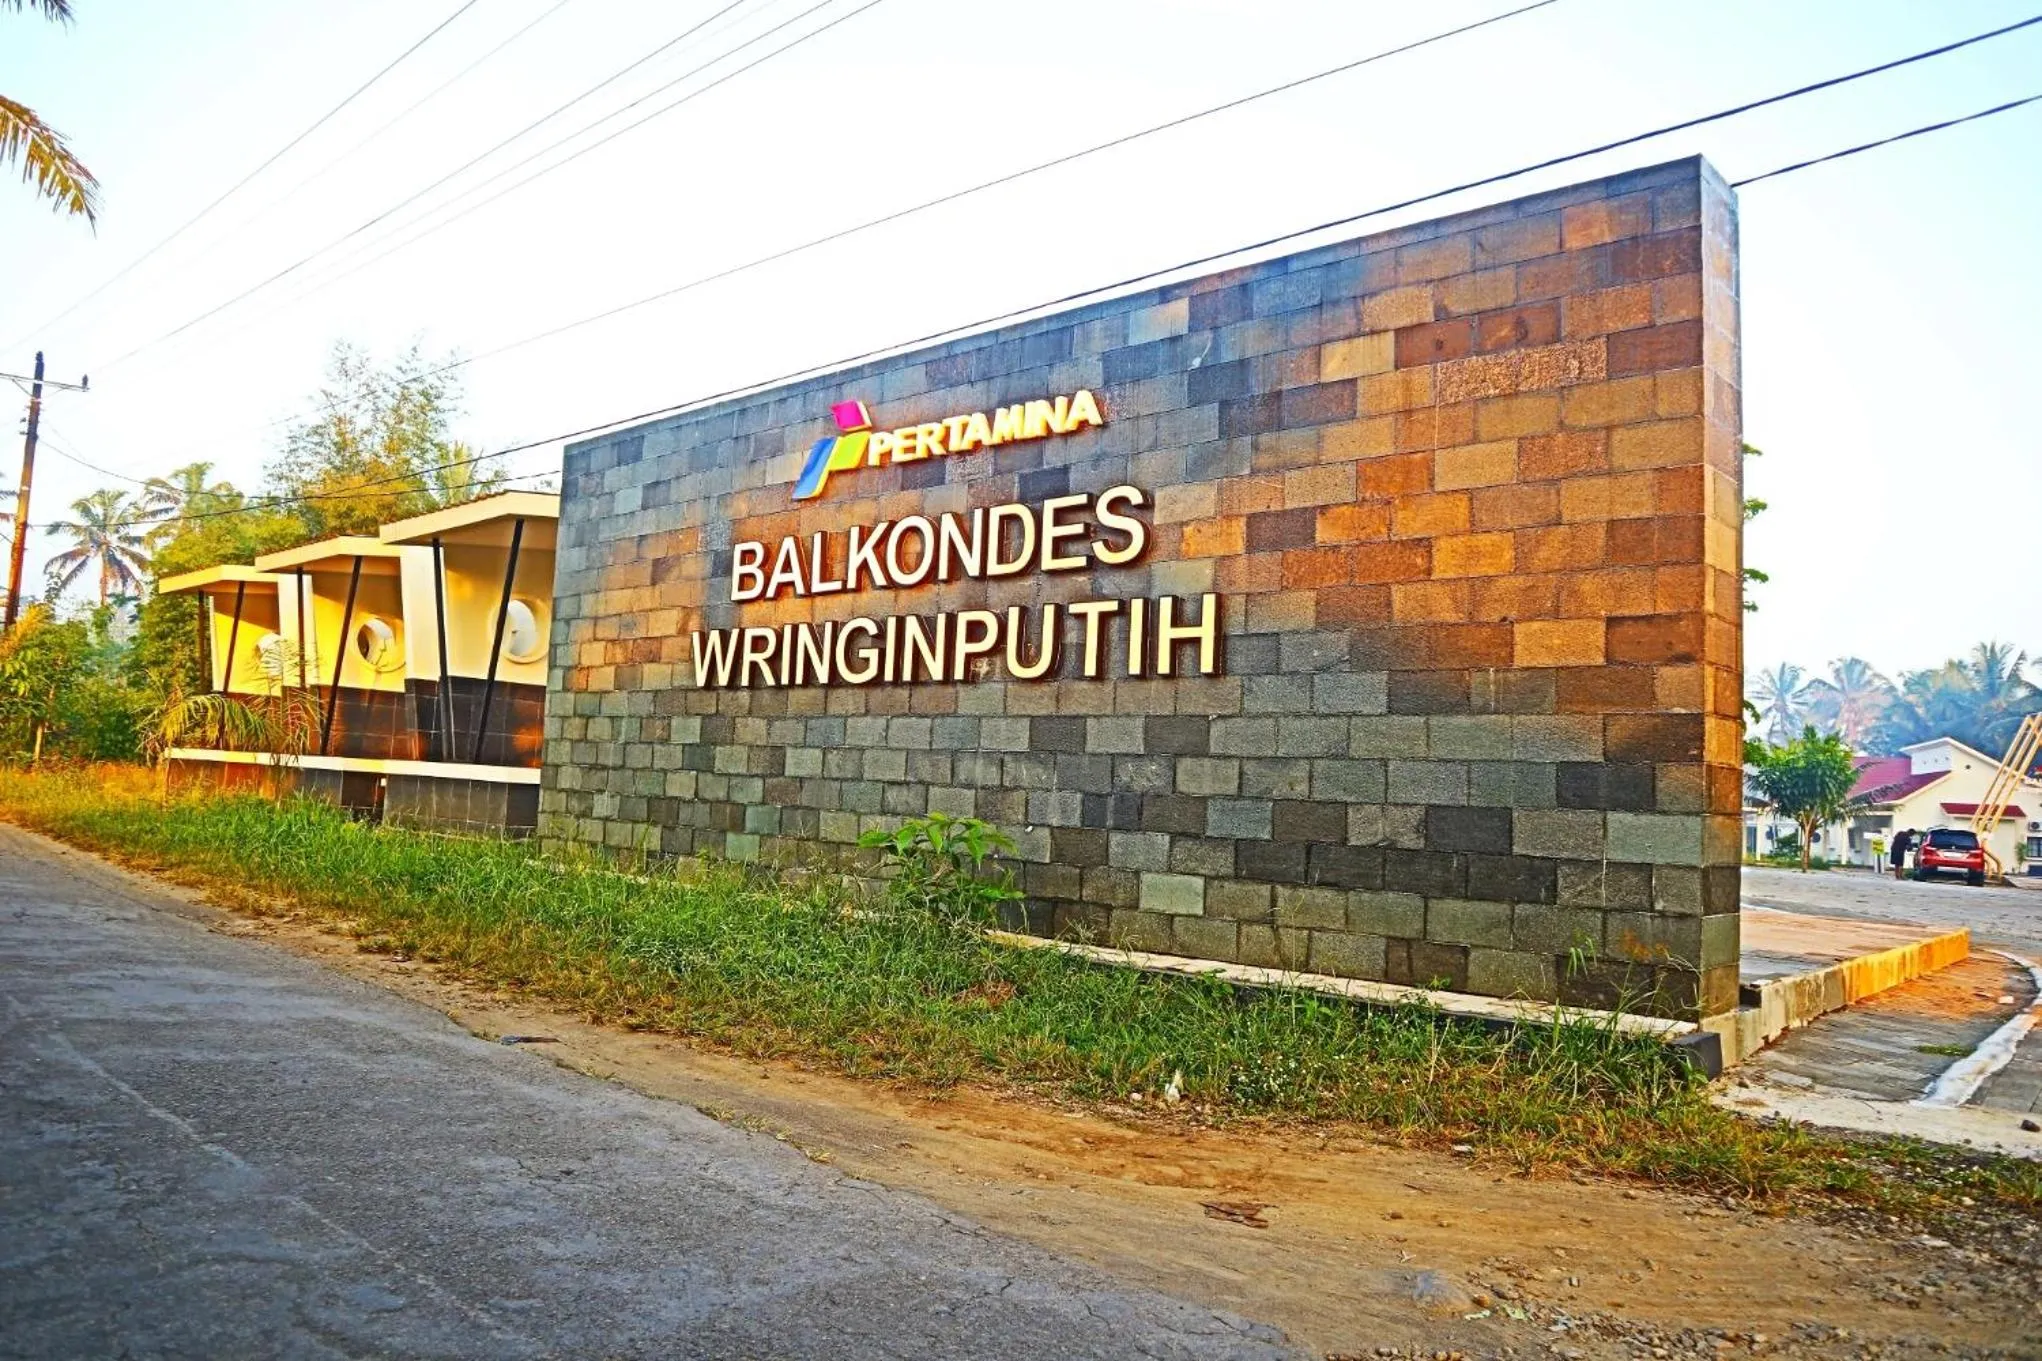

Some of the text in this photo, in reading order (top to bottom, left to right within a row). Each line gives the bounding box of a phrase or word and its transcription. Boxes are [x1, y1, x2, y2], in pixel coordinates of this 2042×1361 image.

[867, 390, 1103, 466] PERTAMINA
[731, 485, 1149, 601] BALKONDES
[692, 593, 1220, 688] WRINGINPUTIH
